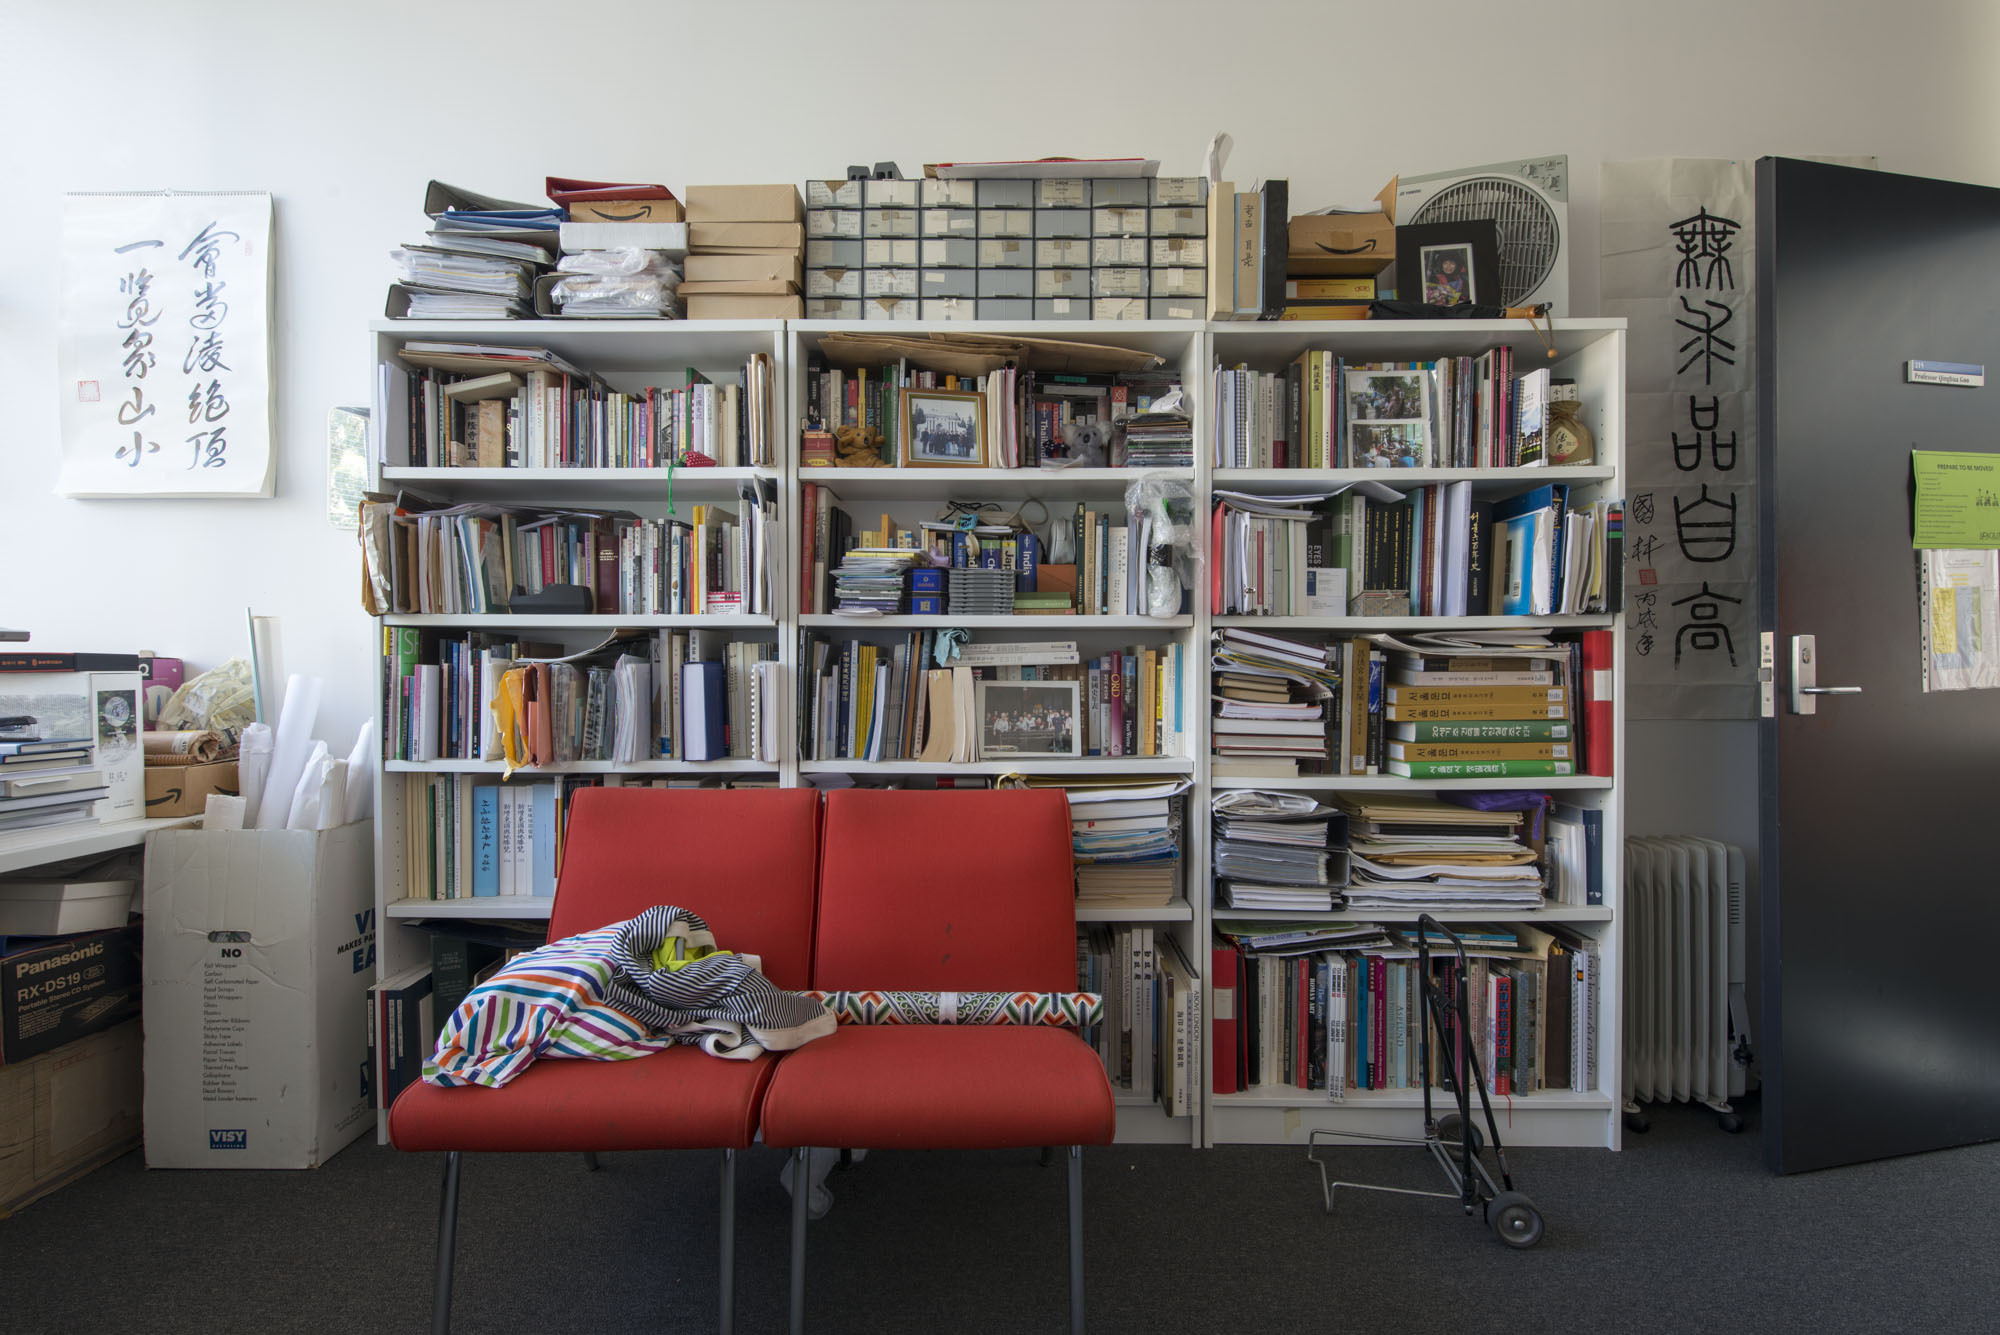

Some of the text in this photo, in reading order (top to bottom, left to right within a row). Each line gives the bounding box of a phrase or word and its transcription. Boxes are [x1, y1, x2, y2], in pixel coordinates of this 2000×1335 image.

[1022, 551, 1033, 576] India
[221, 948, 242, 958] NO
[337, 938, 362, 955] MAKES
[16, 942, 104, 980] Panasonic
[17, 971, 81, 1003] RX-DS19
[211, 1131, 245, 1143] VISY
